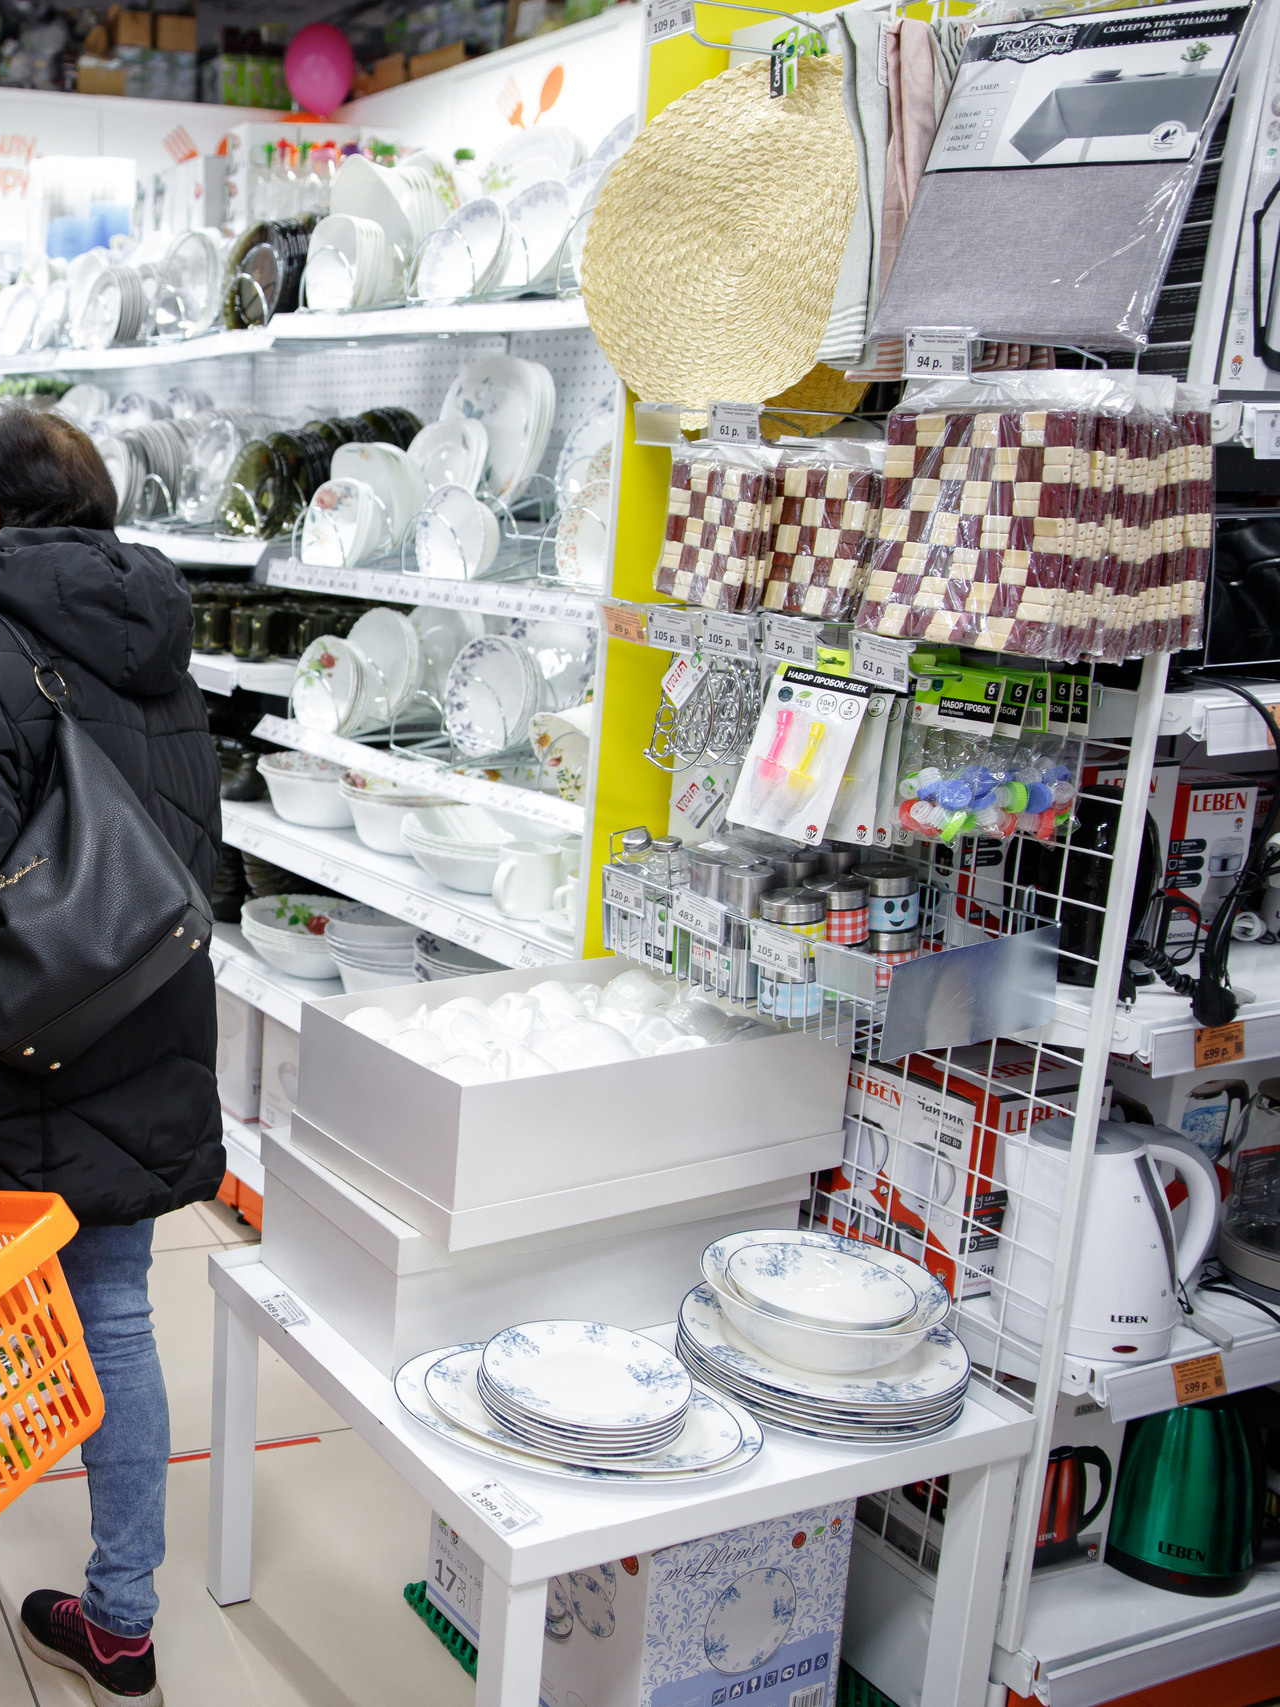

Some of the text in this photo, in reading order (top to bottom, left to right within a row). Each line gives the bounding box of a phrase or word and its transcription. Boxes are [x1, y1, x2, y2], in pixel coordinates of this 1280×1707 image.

[653, 20, 668, 34] 109
[1103, 13, 1228, 34] СКАТЕРТЬ ТЕКСТИЛЬНАЯ
[993, 33, 1075, 52] PROVANCE
[917, 356, 930, 367] 94
[720, 425, 729, 435] 61
[614, 623, 623, 633] 89
[654, 630, 668, 641] 105
[708, 633, 723, 645] 105
[774, 640, 785, 651] 54
[862, 660, 874, 672] 61
[787, 670, 869, 694] НАБОР ПРОБОК-ЛЕЕК
[988, 685, 996, 696] 6
[1015, 686, 1023, 697] 6
[1036, 690, 1043, 699] 6
[1058, 685, 1066, 696] 6
[1075, 685, 1083, 697] 6
[847, 702, 853, 710] 2
[941, 700, 991, 715] НАБОР ПРОБОК
[1192, 791, 1248, 813] LEBEN
[610, 888, 623, 900] 120
[678, 909, 694, 922] 483
[756, 944, 772, 958] 105
[1204, 1048, 1220, 1060] 699
[937, 1133, 952, 1144] 500
[1111, 1314, 1149, 1324] LEBEN
[1185, 1381, 1200, 1394] 599
[476, 1497, 498, 1511] 399
[1038, 1531, 1058, 1542] LEBEN
[1157, 1541, 1207, 1562] LEBEN
[434, 1558, 467, 1608] 17 PCS
